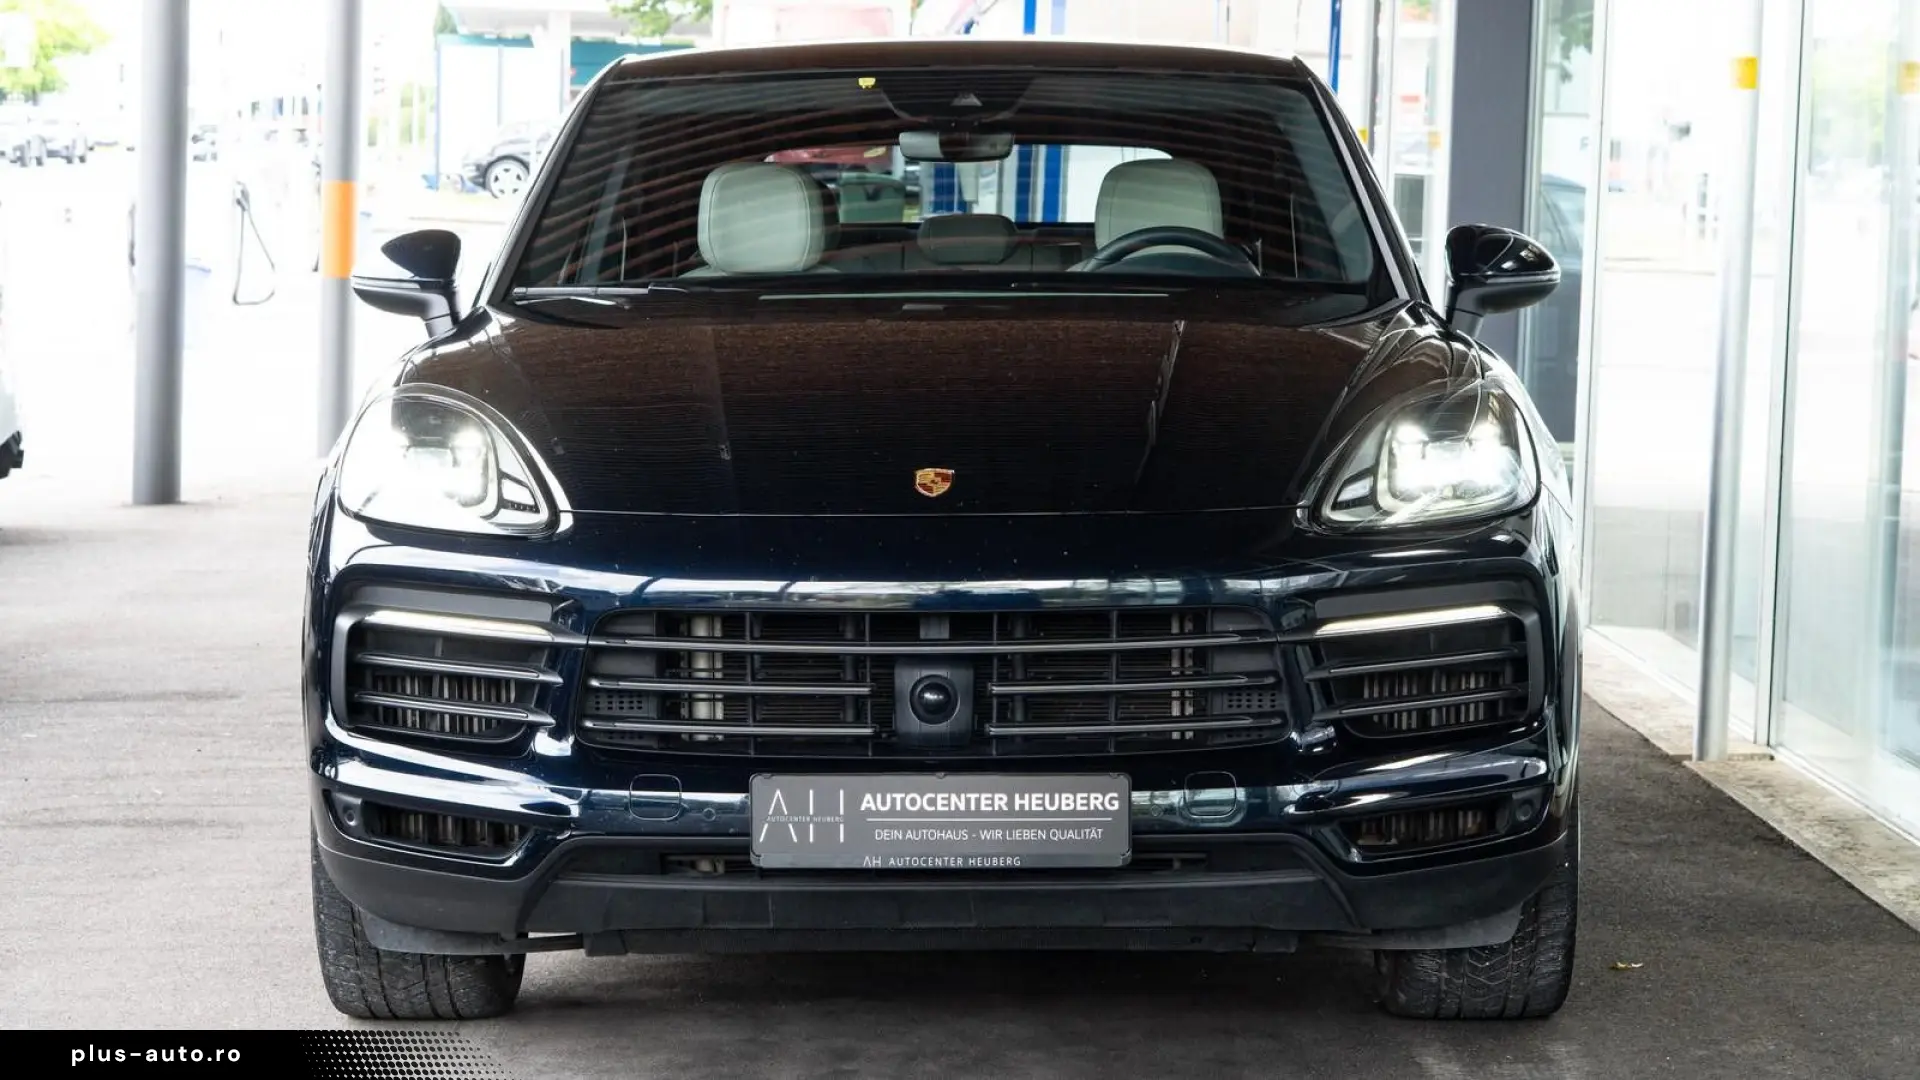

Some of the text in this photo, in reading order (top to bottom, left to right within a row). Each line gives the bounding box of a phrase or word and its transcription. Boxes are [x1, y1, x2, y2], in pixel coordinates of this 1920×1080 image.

[860, 792, 1120, 811] AUTOCENTER HEUBERG
[760, 789, 844, 843] AH
[875, 829, 902, 841] DEIN
[905, 829, 969, 841] AUTOHAUS
[979, 829, 1003, 841] WIR
[1006, 828, 1046, 841] LIEBEN
[1049, 826, 1103, 842] QUALITÄT
[863, 855, 1021, 867] AH AUTOCENTER HEUBERG
